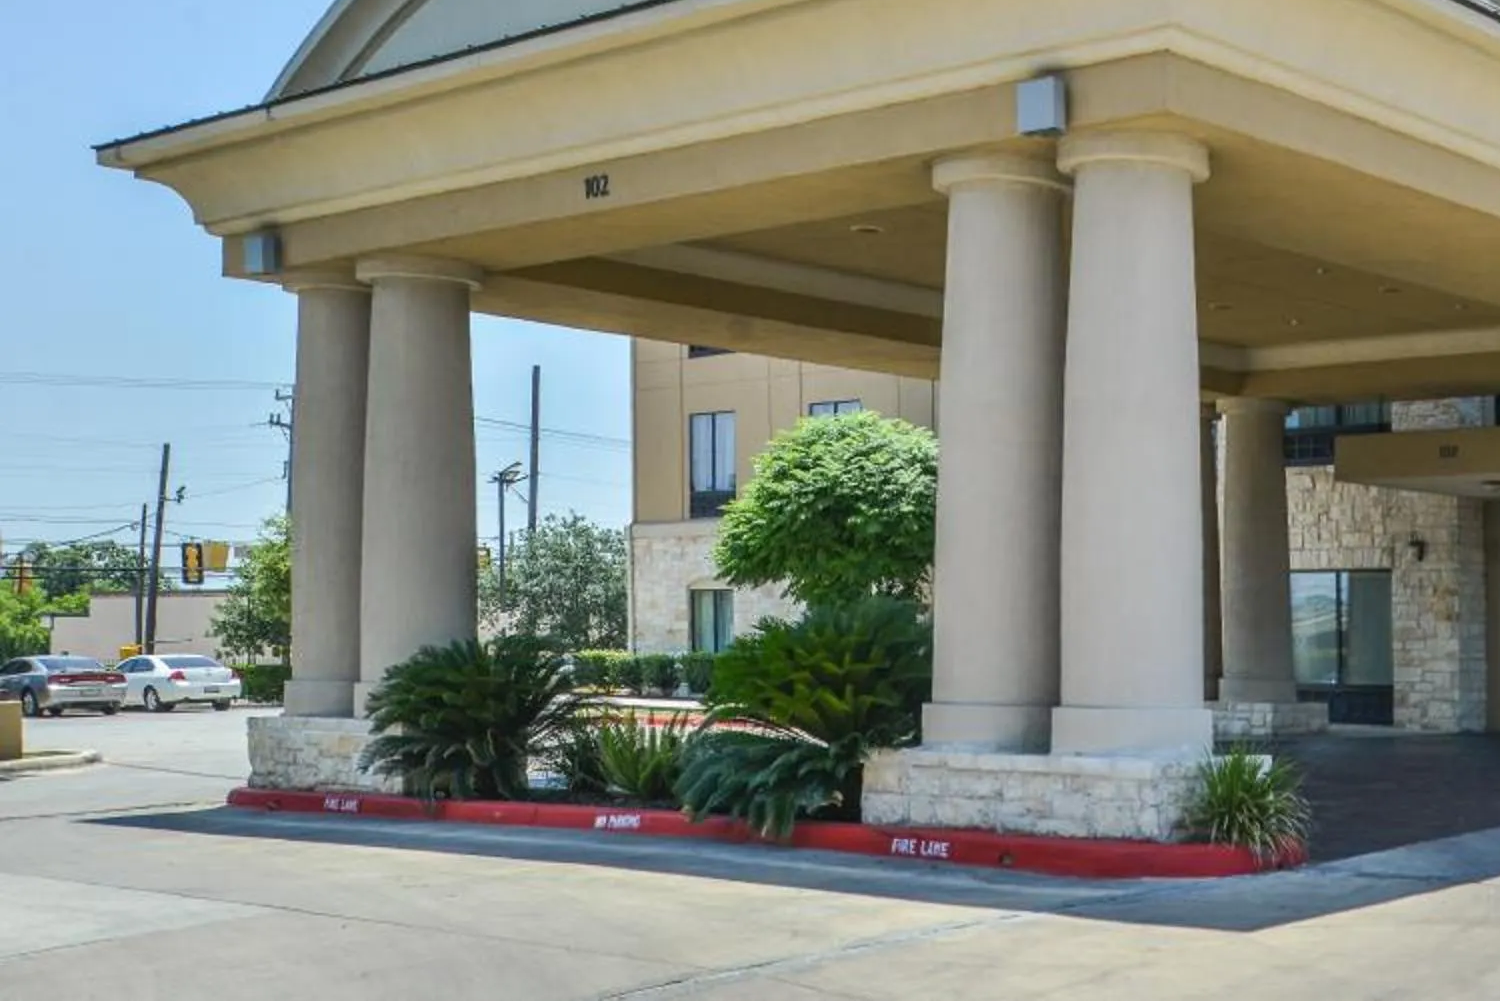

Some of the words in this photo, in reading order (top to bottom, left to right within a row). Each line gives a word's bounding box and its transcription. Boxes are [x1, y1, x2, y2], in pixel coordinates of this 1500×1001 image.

[584, 174, 610, 200] 102
[891, 837, 917, 855] FIRE
[920, 839, 950, 858] LANE
